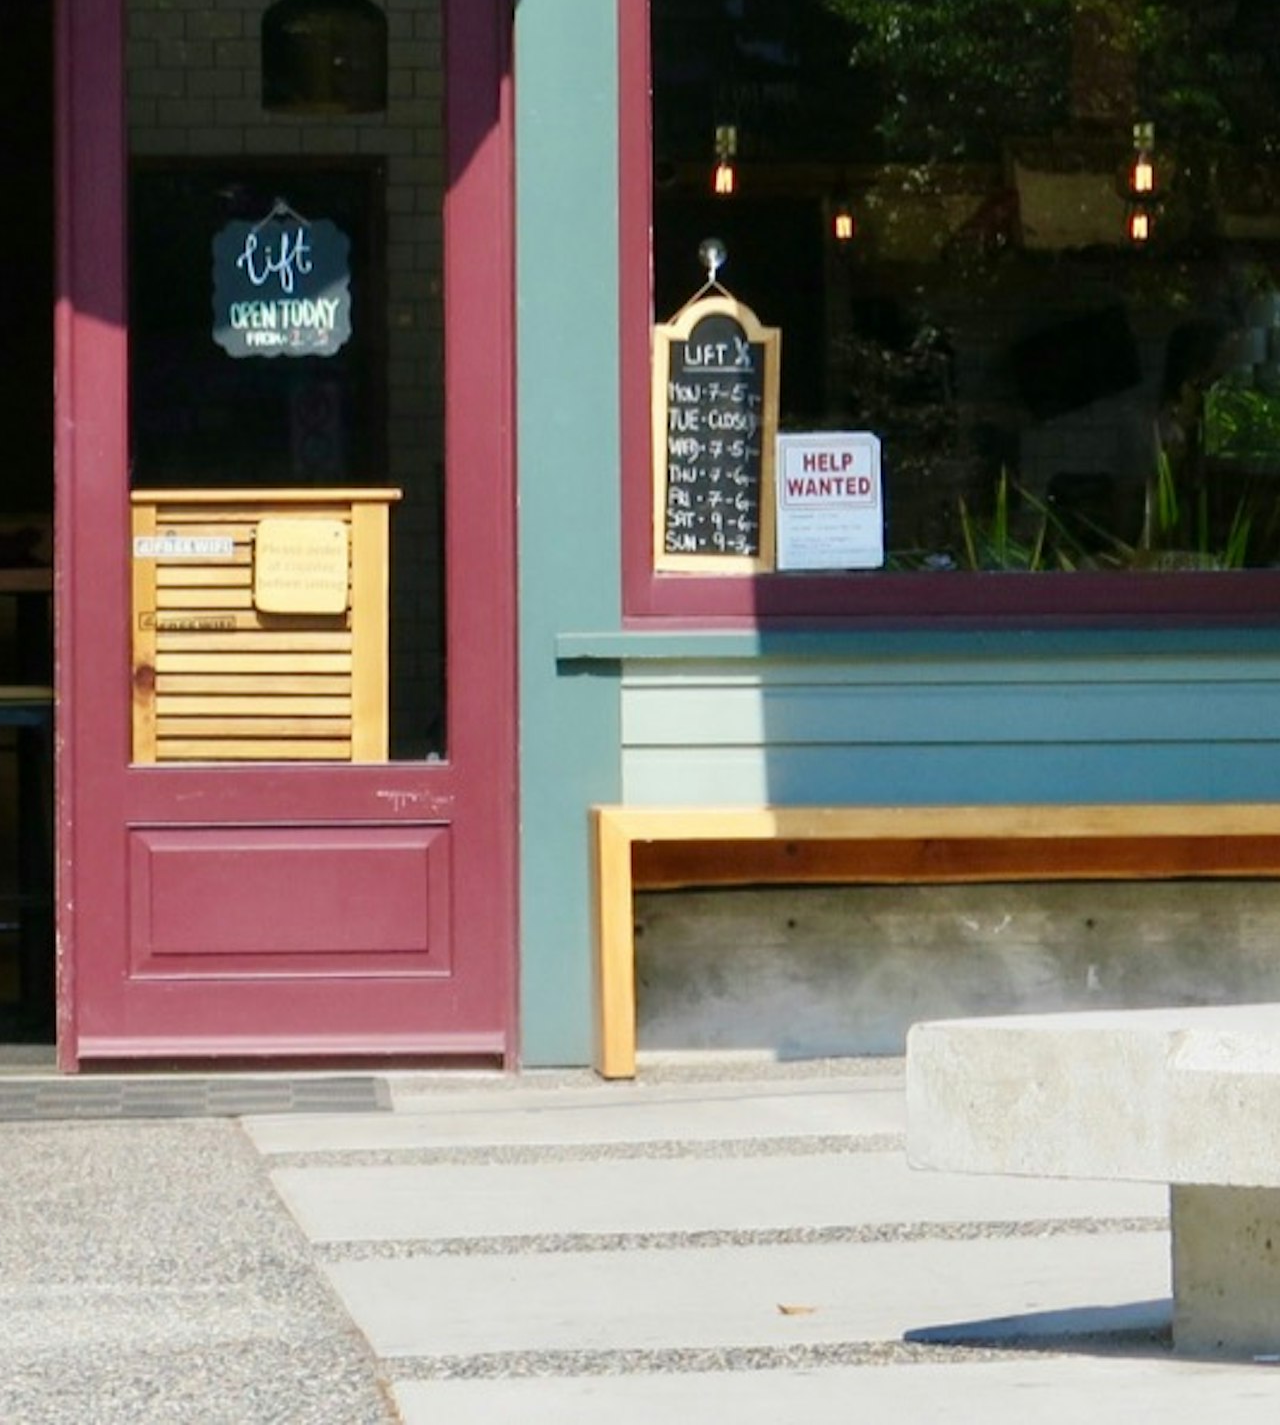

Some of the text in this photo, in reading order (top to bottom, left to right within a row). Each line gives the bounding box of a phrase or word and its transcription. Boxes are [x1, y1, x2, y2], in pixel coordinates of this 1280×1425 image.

[236, 228, 313, 294] lift
[230, 297, 340, 330] OPEN TODAY
[684, 343, 728, 366] LIFT
[669, 408, 699, 432] TUE
[803, 452, 853, 472] HELP
[788, 476, 871, 496] WANTED
[666, 508, 696, 529] SAT
[665, 529, 697, 552] SUN
